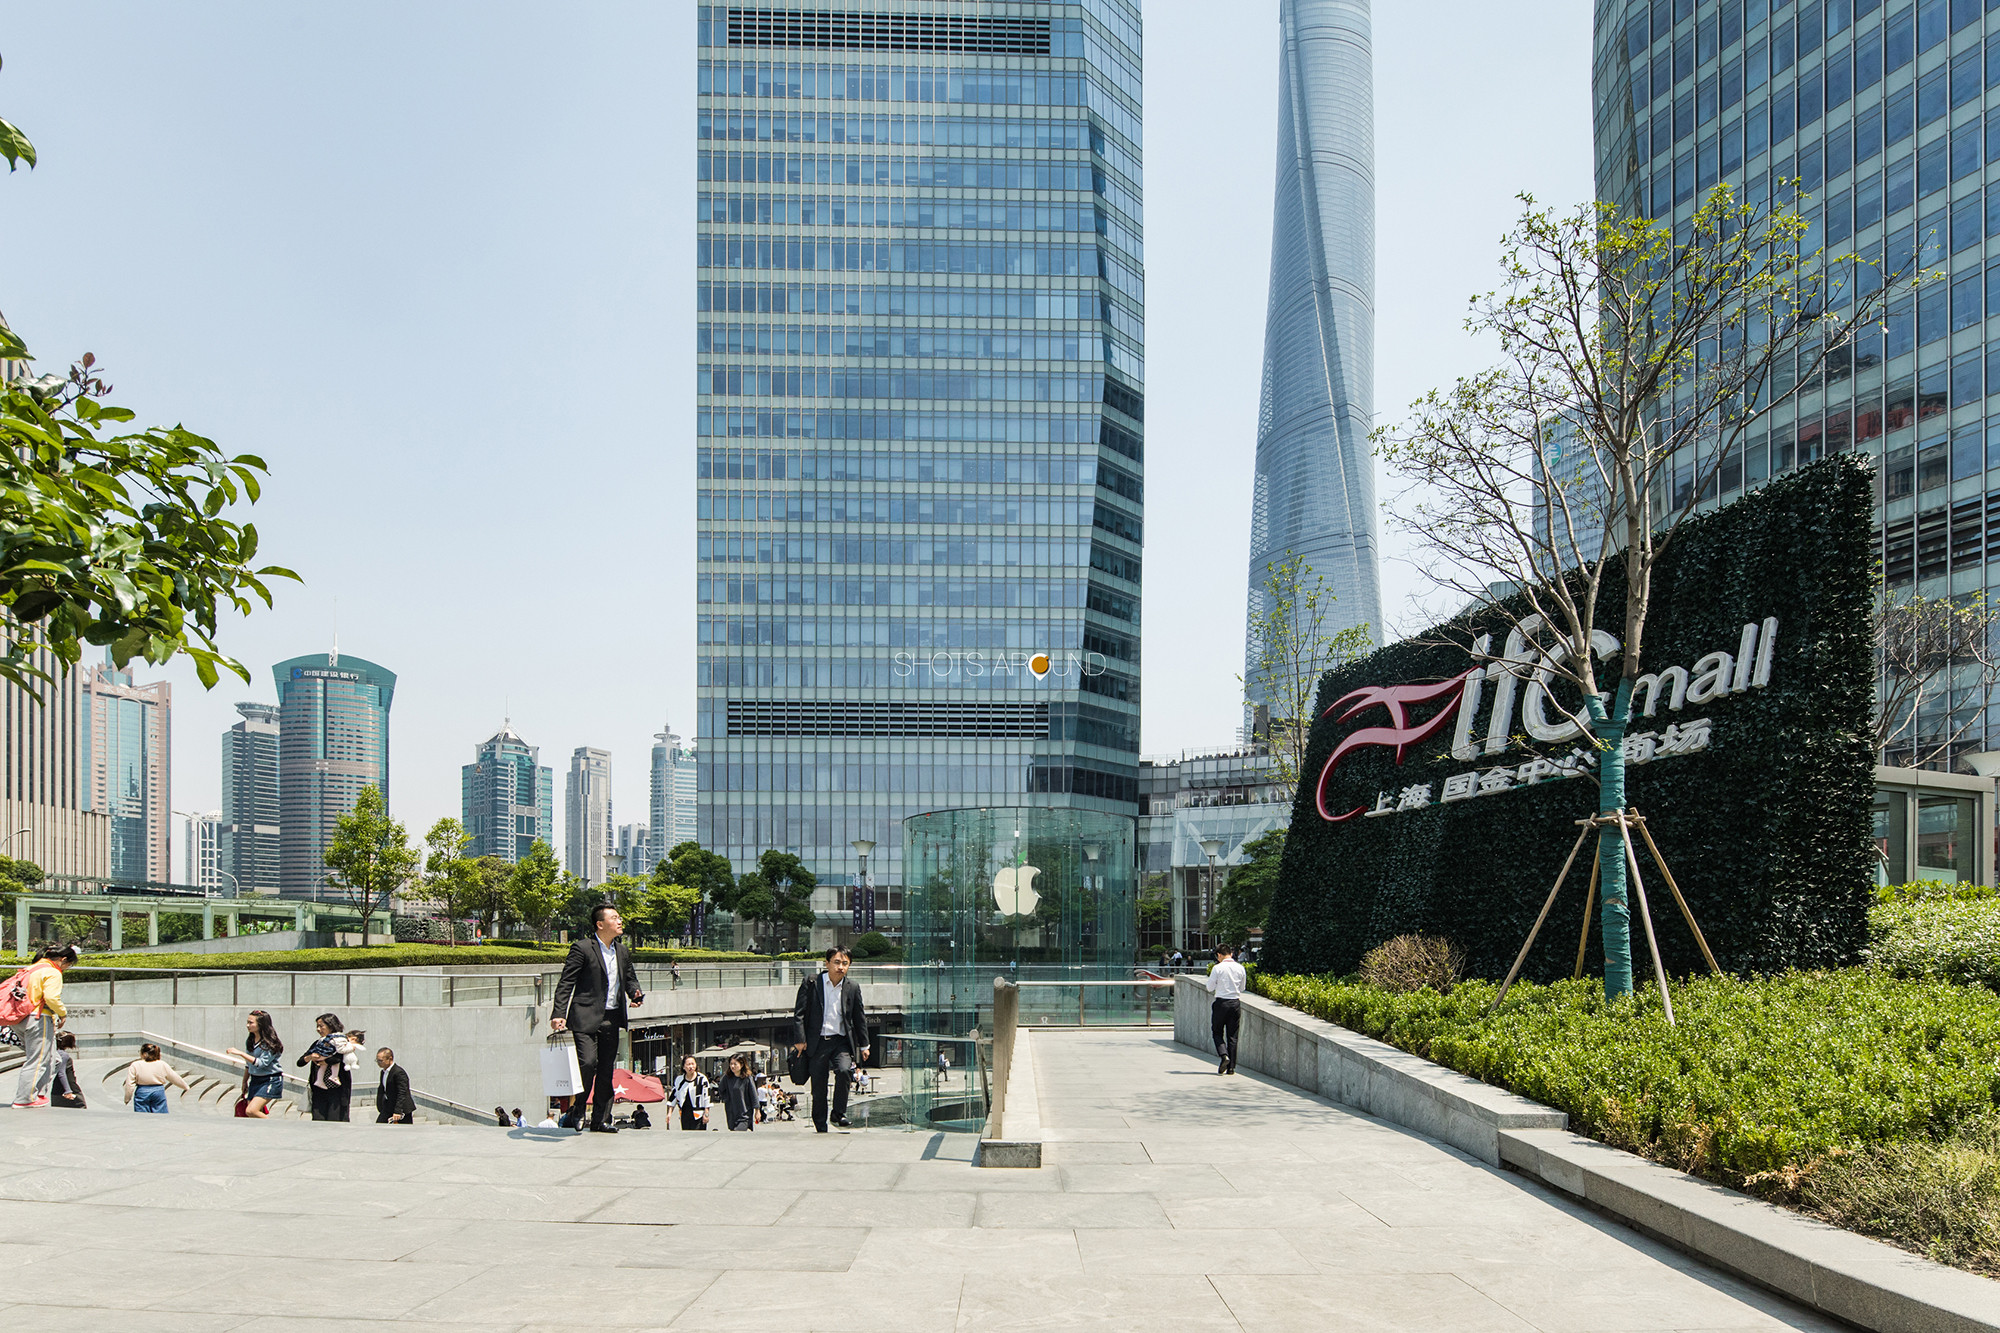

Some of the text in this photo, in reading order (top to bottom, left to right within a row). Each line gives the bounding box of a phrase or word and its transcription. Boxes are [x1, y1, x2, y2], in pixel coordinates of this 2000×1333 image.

[304, 670, 359, 680] 中国建设银行
[1452, 613, 1778, 762] ifc mall
